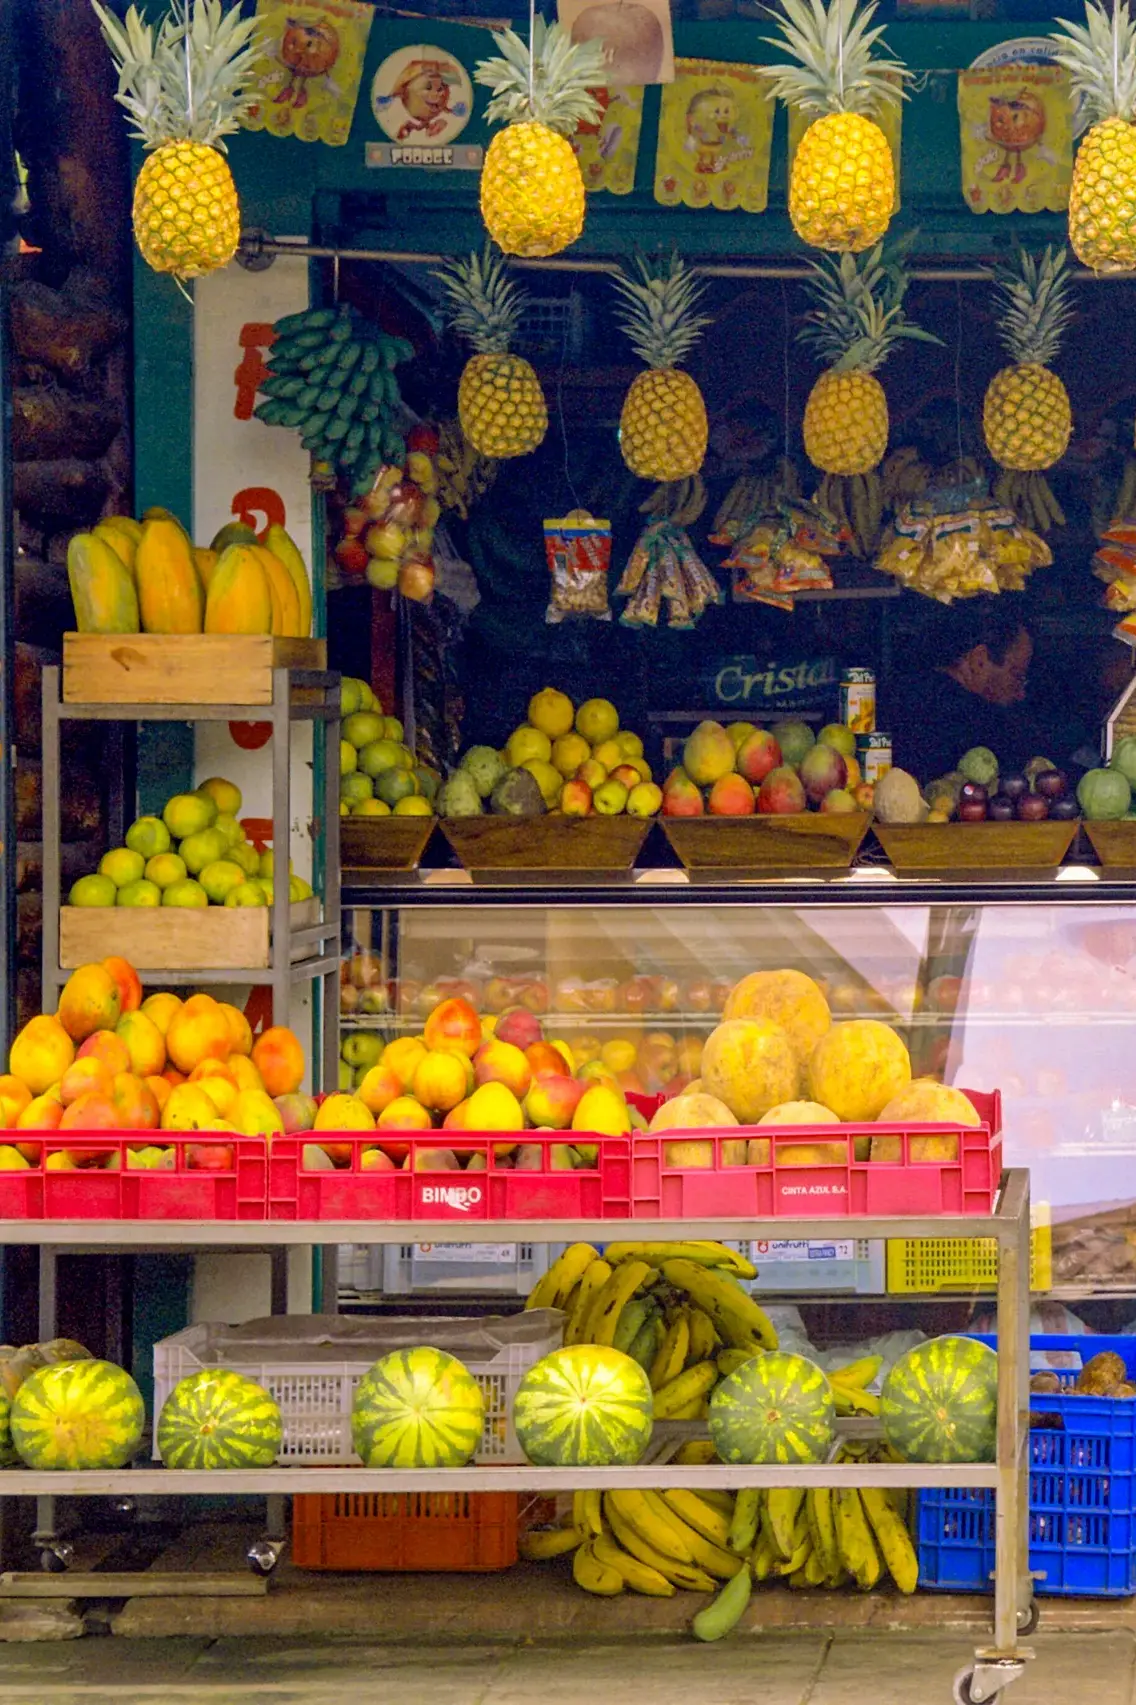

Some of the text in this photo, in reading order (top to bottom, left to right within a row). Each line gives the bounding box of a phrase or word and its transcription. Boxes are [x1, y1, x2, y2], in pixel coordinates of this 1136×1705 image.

[422, 1187, 482, 1203] BIMBO
[782, 1185, 848, 1195] CINTA AZUL S.A.
